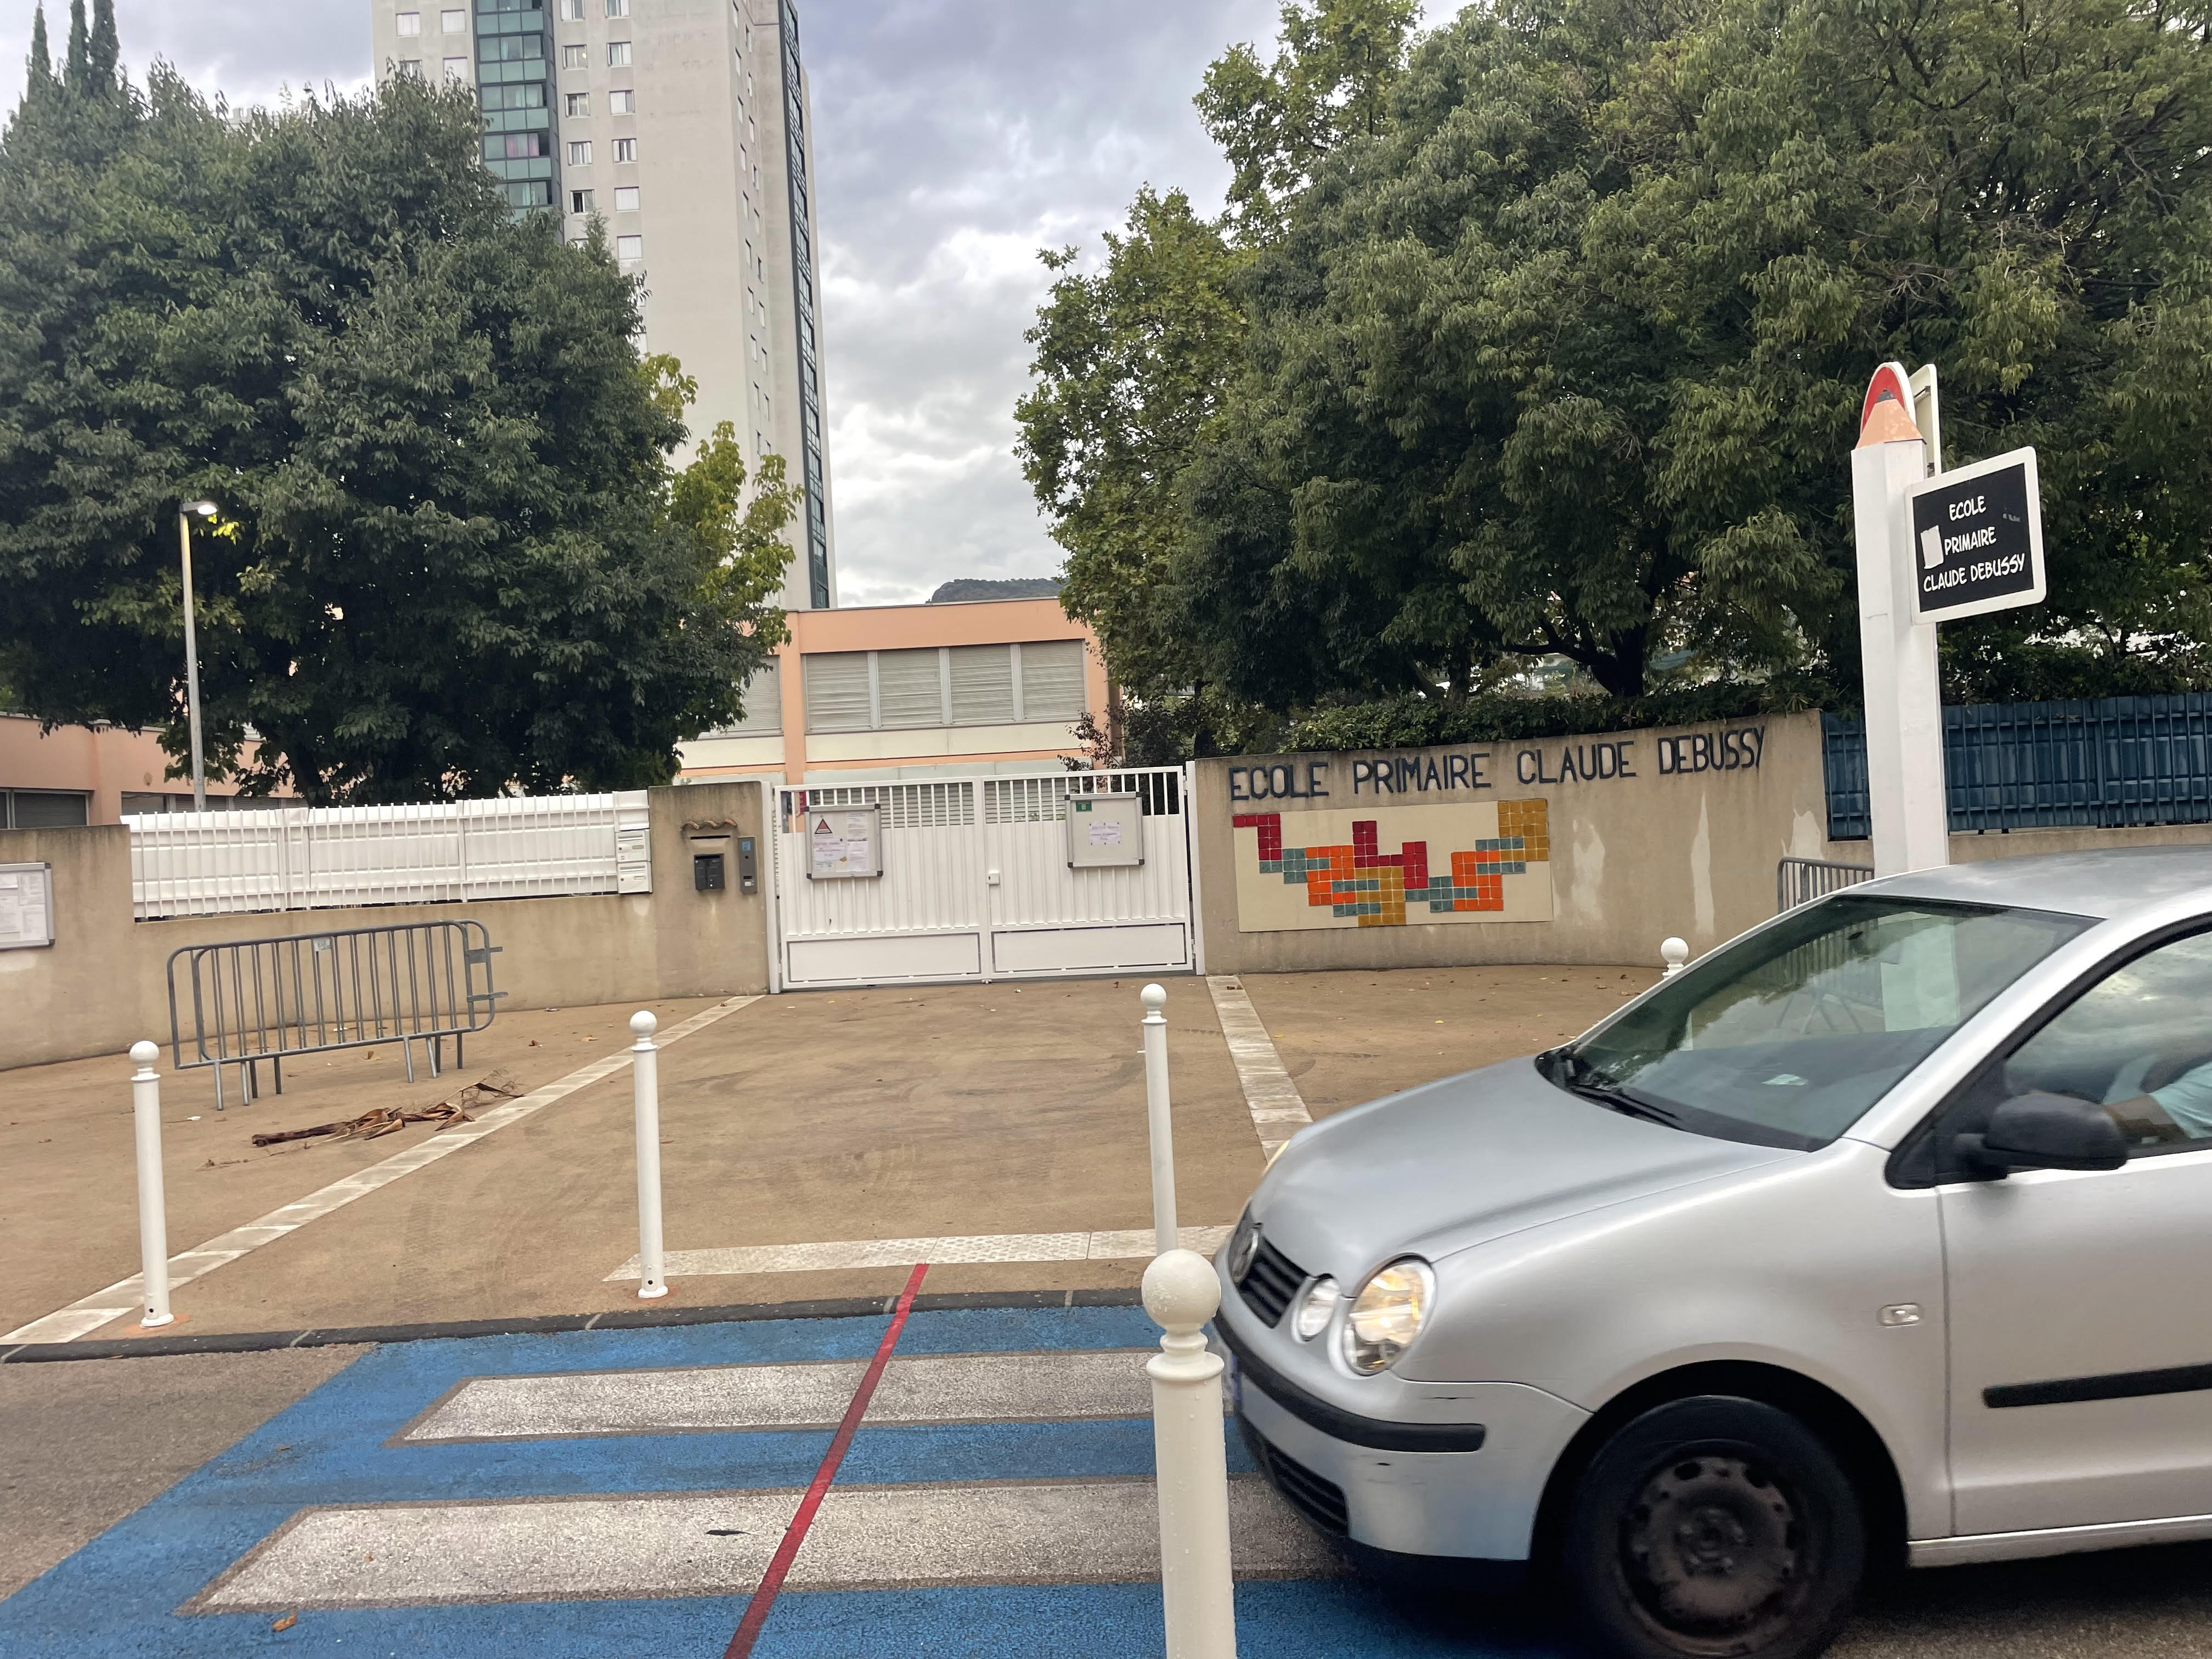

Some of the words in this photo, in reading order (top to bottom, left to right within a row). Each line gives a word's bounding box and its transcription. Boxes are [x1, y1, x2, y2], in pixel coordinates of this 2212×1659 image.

[1949, 495, 1987, 521] ECOLE
[1944, 526, 1997, 555] PRIMAIRE
[1923, 567, 1967, 592] CLAUDE
[1970, 553, 2025, 582] DEBUSSY
[1229, 761, 1329, 801] ECOLE
[1352, 753, 1492, 794] PRIMAIRE
[1517, 741, 1637, 785] CLAUDE
[1657, 726, 1765, 775] DEBUSSY
